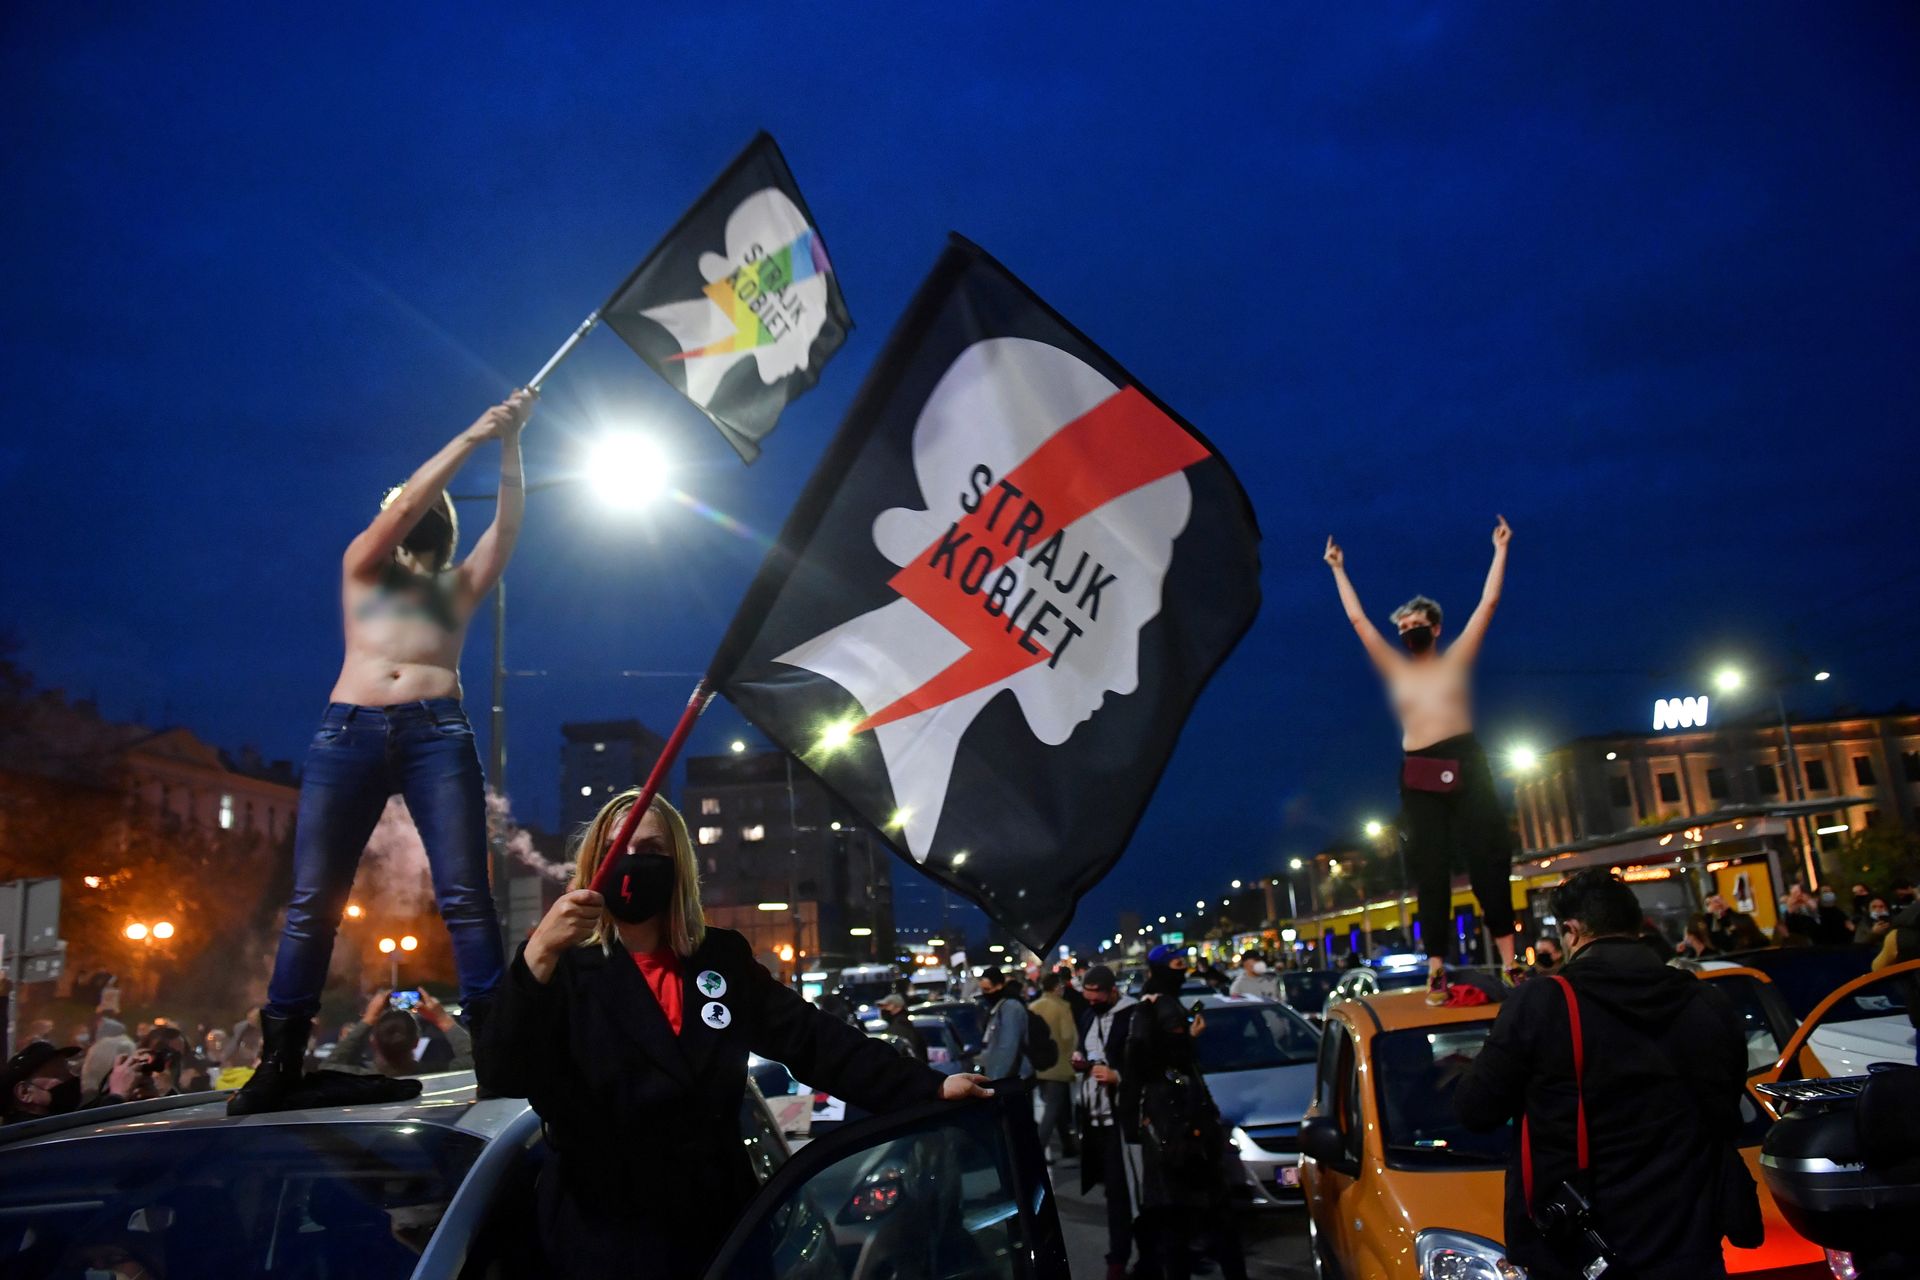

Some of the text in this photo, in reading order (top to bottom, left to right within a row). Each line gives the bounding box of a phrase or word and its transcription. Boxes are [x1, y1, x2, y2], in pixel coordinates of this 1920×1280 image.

[727, 265, 791, 343] KOBIET
[744, 243, 807, 326] STRAJK
[929, 522, 1083, 670] KOBIET
[961, 463, 1118, 622] STRAJK
